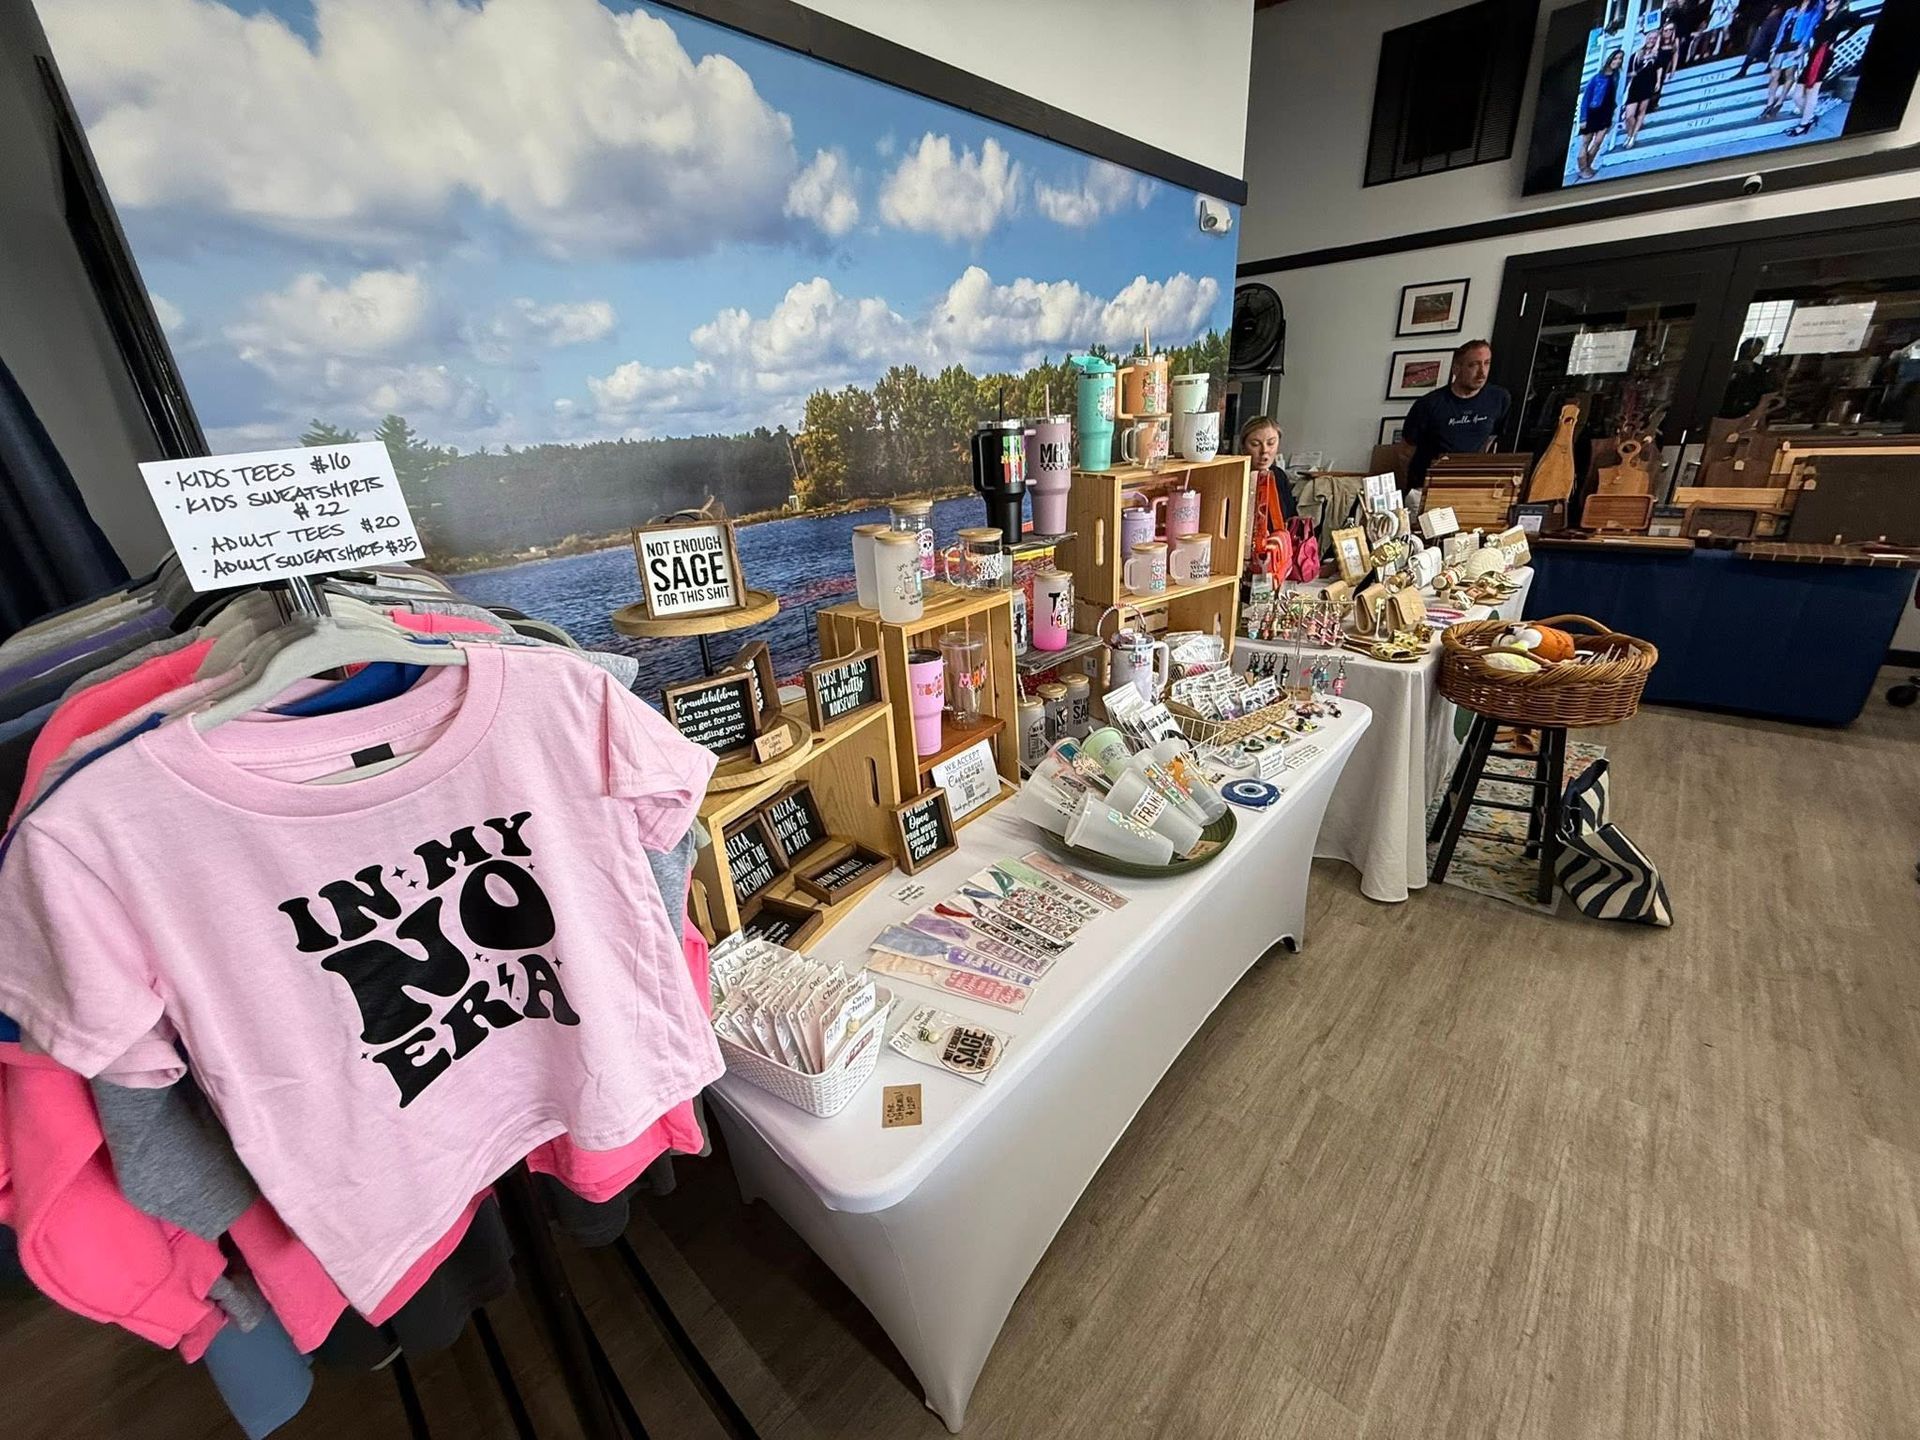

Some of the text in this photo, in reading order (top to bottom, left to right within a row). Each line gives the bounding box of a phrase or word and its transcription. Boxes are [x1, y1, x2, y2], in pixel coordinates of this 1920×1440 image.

[177, 469, 230, 491] KIDS
[232, 463, 295, 486] TEES
[186, 476, 384, 515] KIDS SWEATSHIRTS
[211, 515, 400, 555] ADULT TEES $20
[646, 535, 722, 558] NOT ENOUGH
[213, 536, 418, 579] ADULT SWEATSHIRTS $35
[650, 551, 729, 592] SAGE
[656, 585, 730, 607] FOR THIS SHIT
[816, 668, 838, 690] XCUSE
[830, 686, 837, 699] A
[677, 700, 741, 724] are the reward
[680, 711, 743, 735] you get for not
[1073, 704, 1088, 720] SA
[725, 721, 746, 736] your
[772, 796, 800, 823] ALEXA,
[796, 808, 809, 827] ME
[908, 812, 930, 830] Open
[785, 827, 812, 856] A BEER
[914, 836, 938, 860] Closed
[728, 843, 769, 881] HANGE THE
[277, 811, 533, 953] IN MY
[320, 858, 556, 1045] NO
[371, 953, 581, 1109] ERA
[942, 1048, 953, 1062] NOT
[952, 1026, 986, 1068] SAGE
